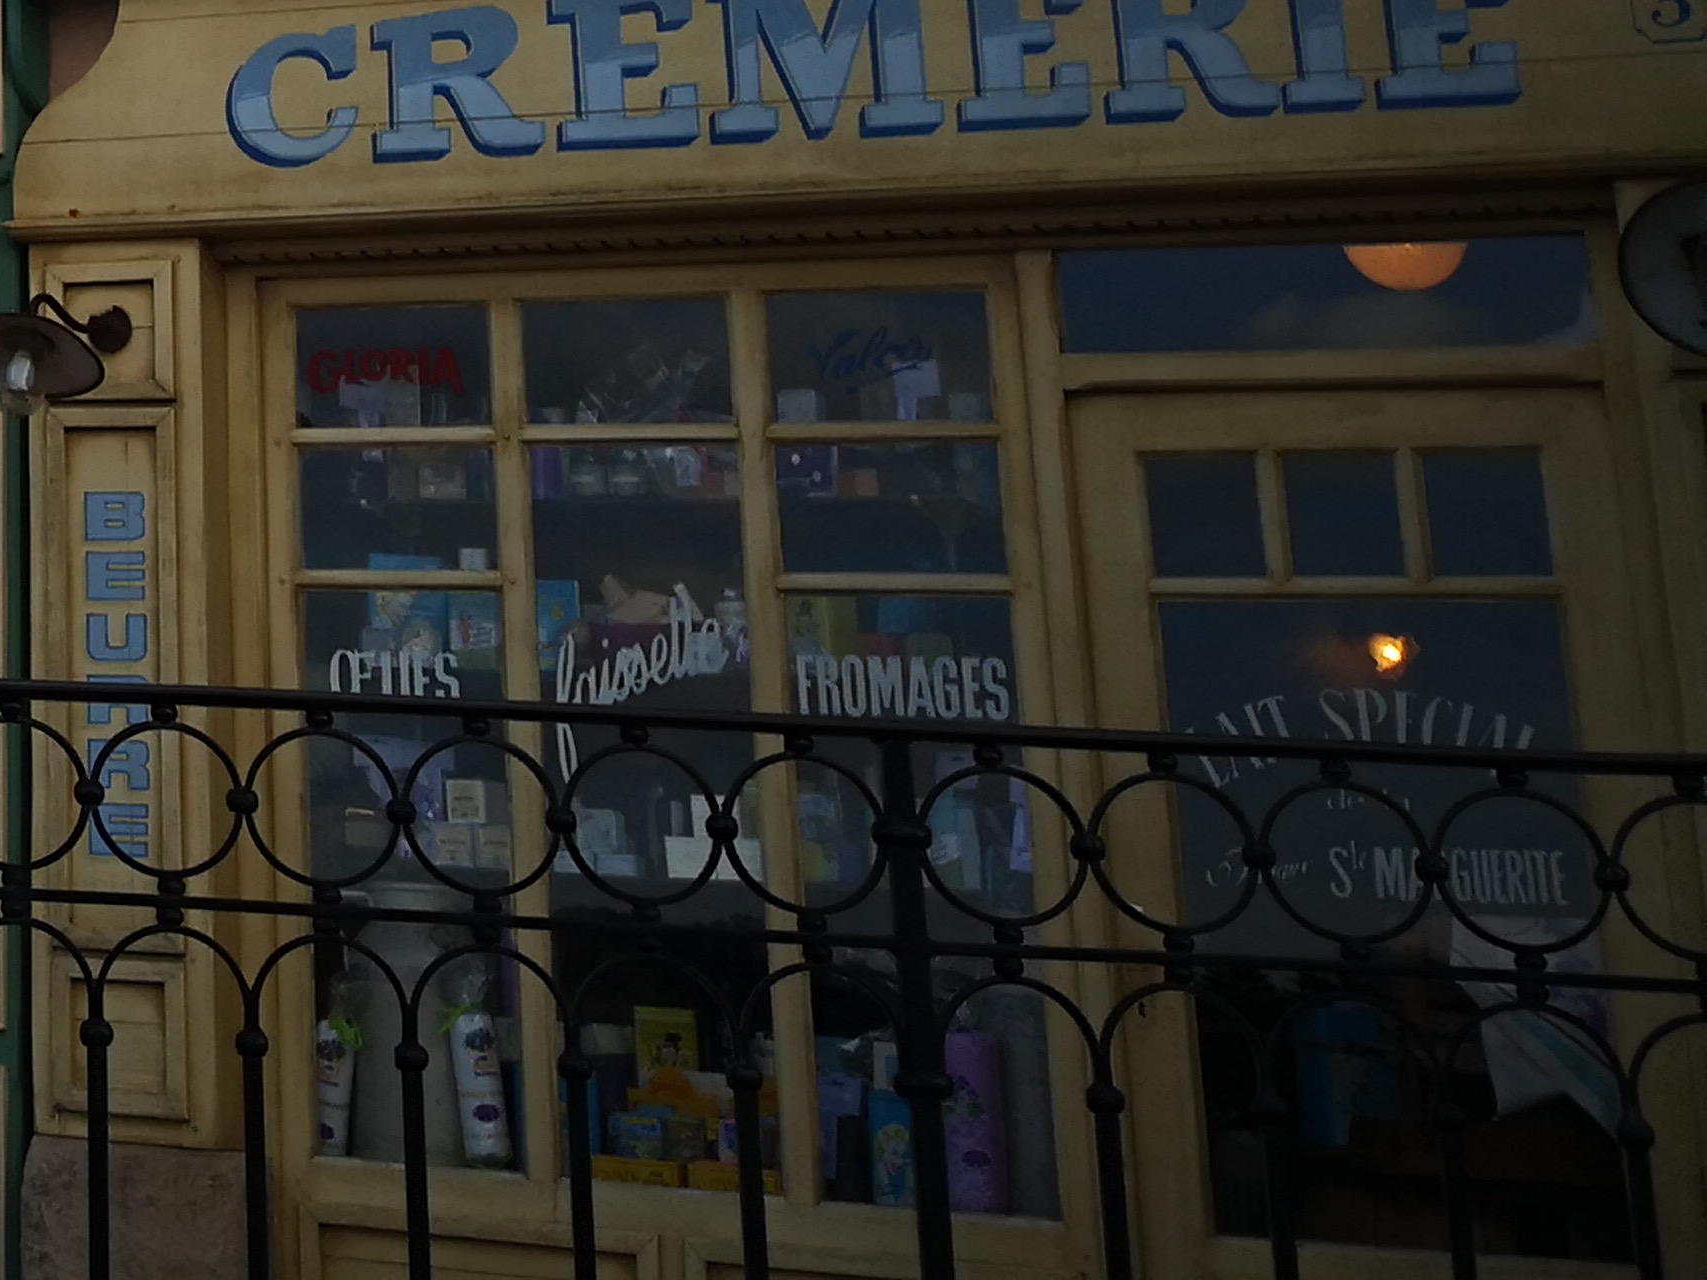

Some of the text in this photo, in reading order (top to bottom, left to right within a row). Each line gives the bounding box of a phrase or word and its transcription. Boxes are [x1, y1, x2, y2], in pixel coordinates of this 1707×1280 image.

[307, 346, 464, 396] GLORIA
[83, 490, 151, 858] BEURRE
[796, 653, 1011, 720] FROMAGES
[1373, 846, 1570, 907] MAGUERITE
